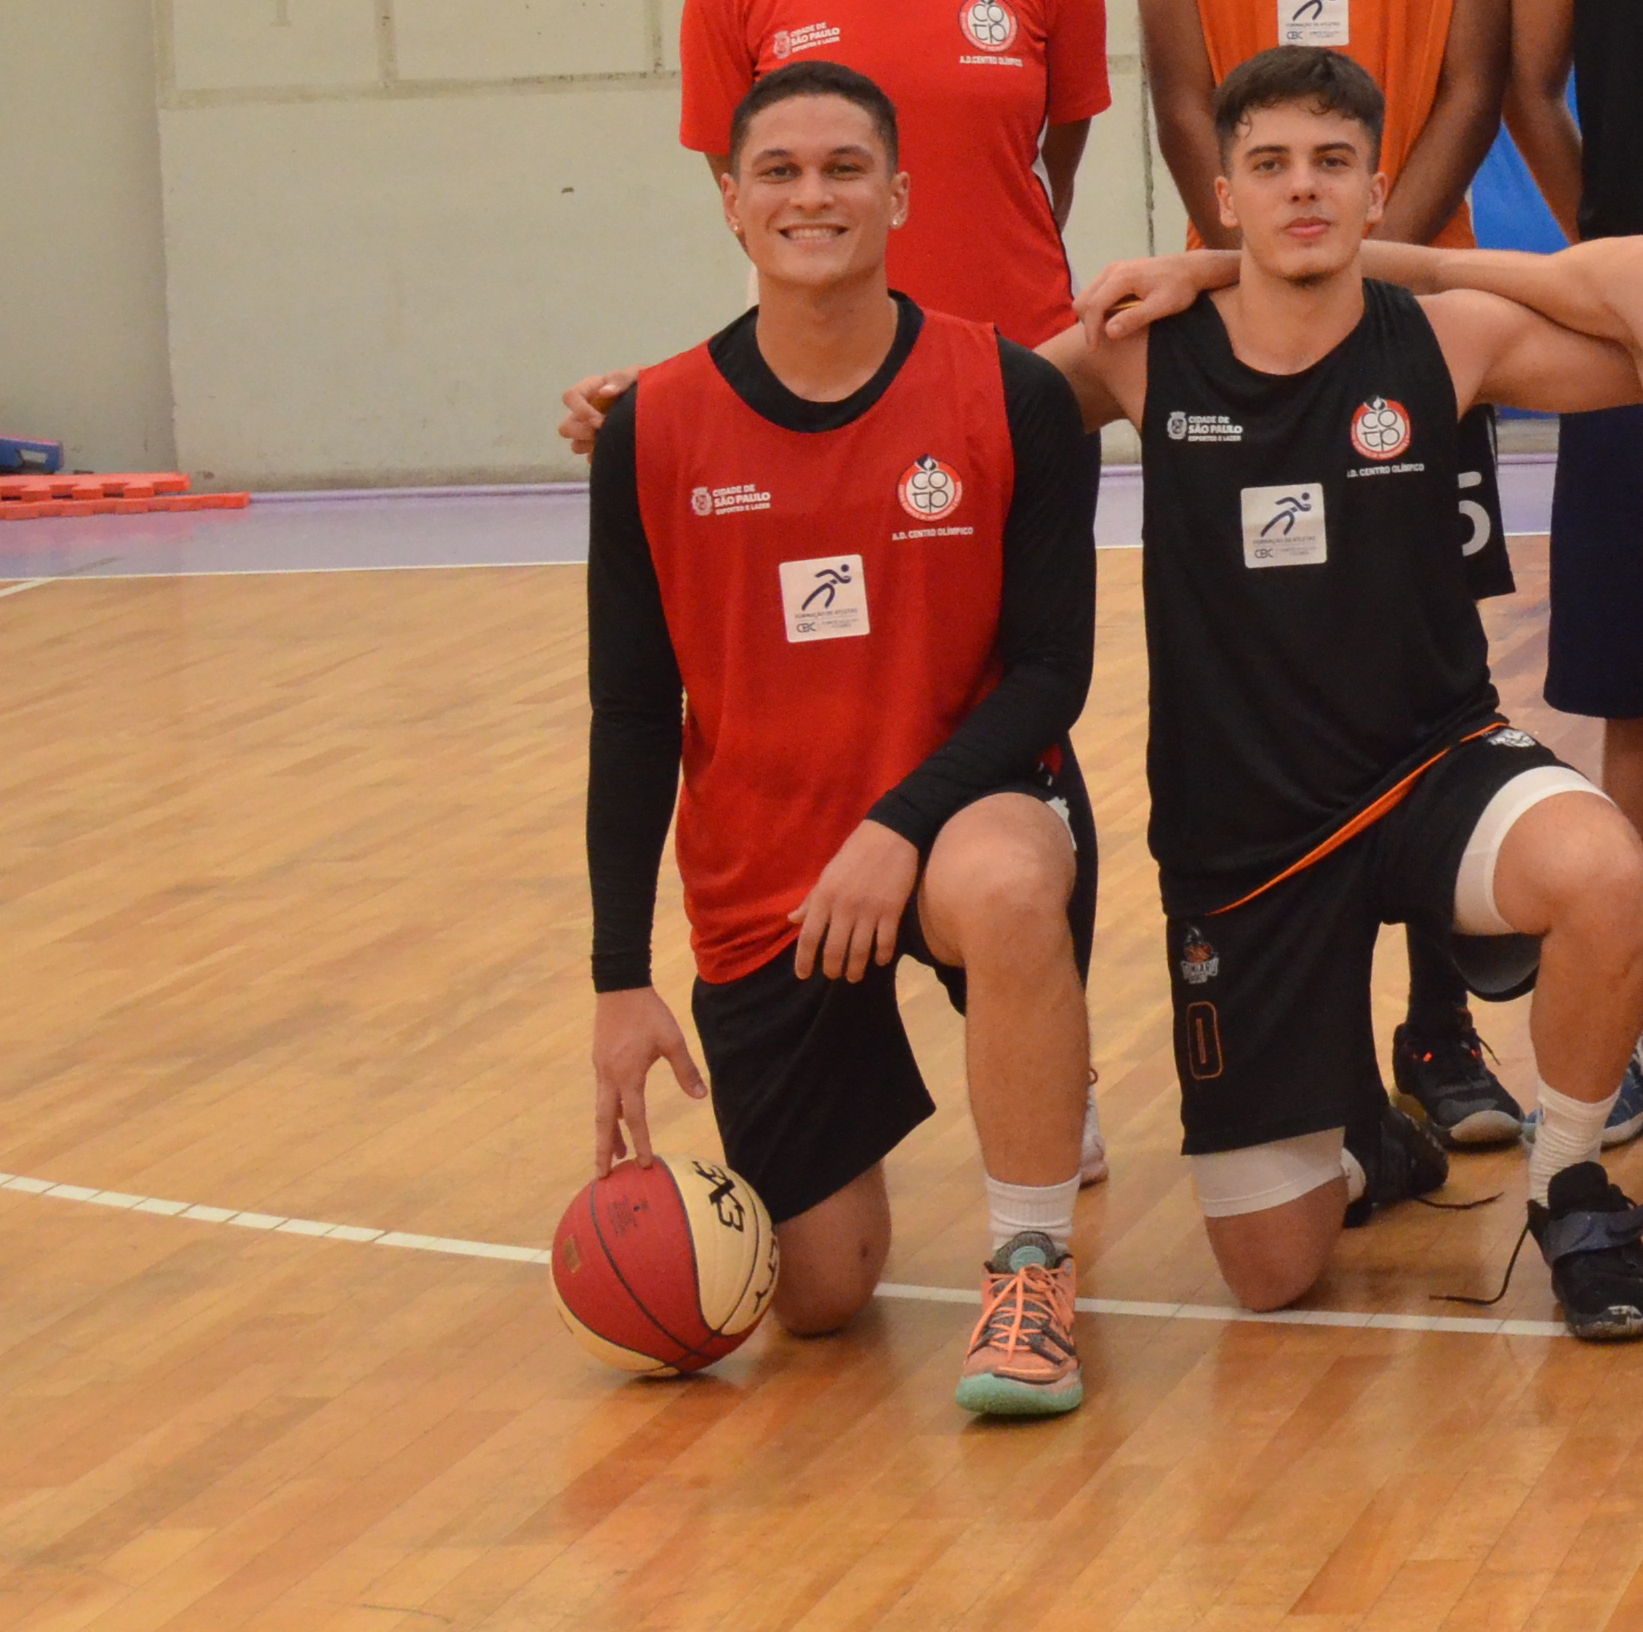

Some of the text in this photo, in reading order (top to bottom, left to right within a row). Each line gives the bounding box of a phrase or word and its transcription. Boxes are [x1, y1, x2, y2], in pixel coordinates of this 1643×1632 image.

[809, 27, 840, 41] PAULO
[1188, 423, 1243, 434] SÃO PAULO
[712, 484, 756, 497] CIDADE DE
[714, 492, 771, 507] SÃO PAULO
